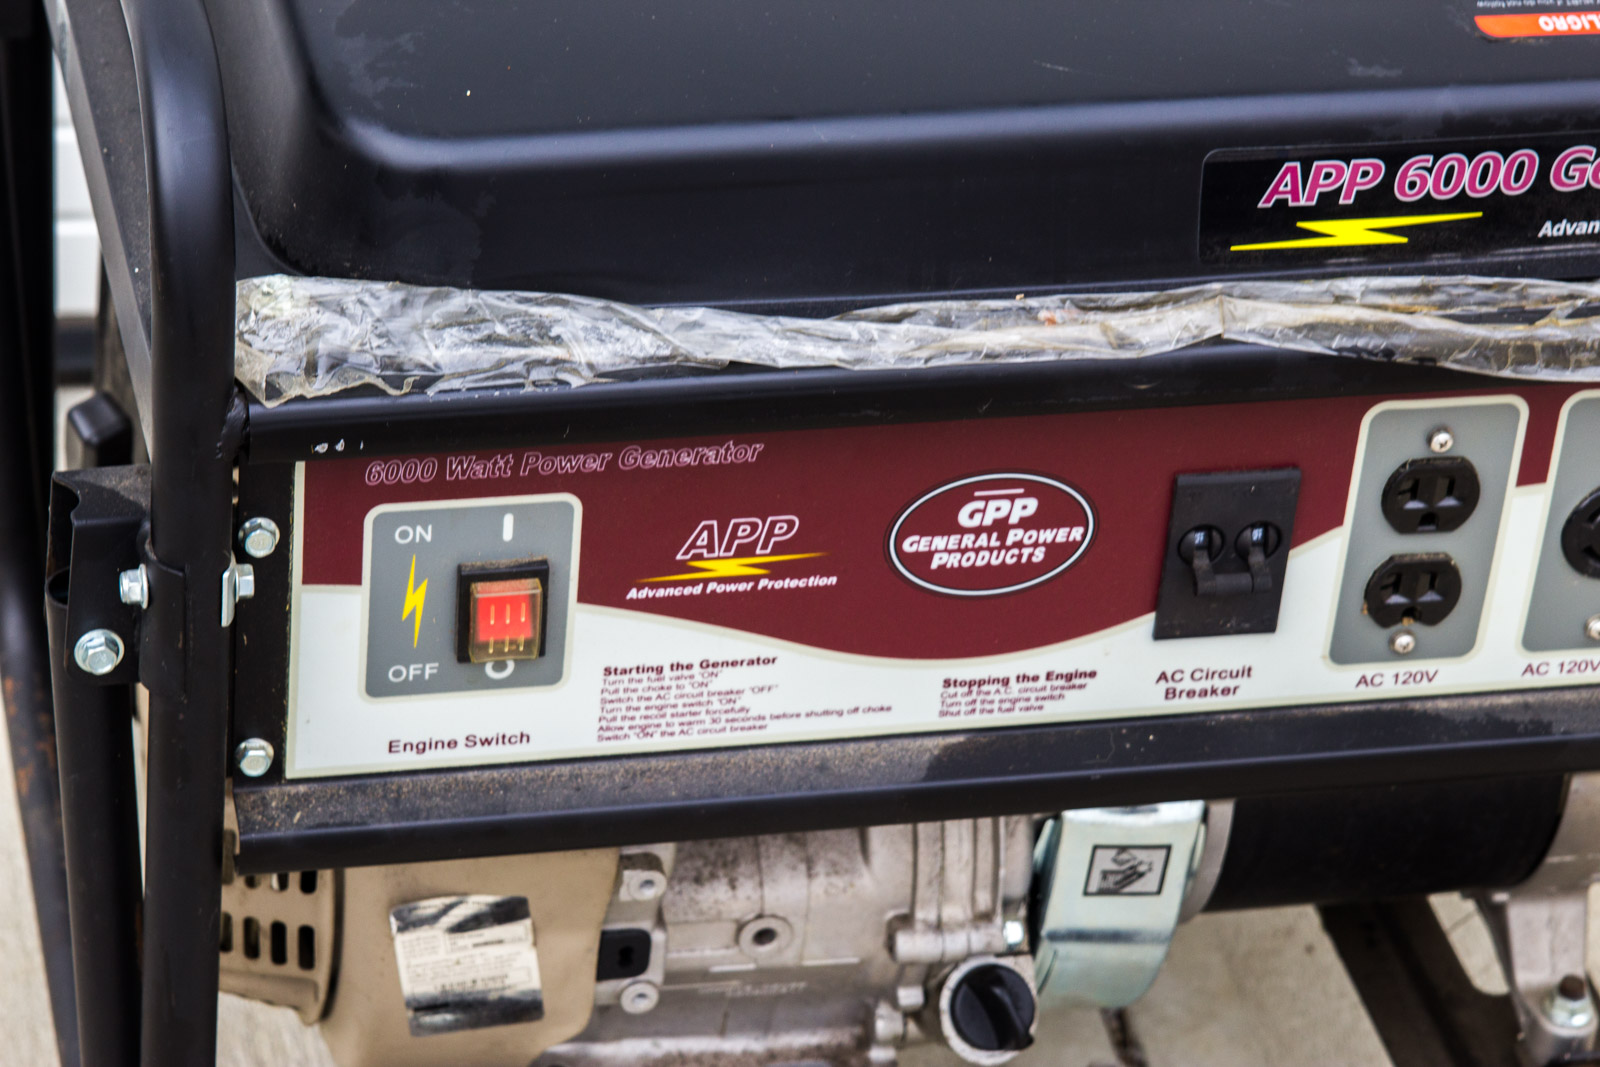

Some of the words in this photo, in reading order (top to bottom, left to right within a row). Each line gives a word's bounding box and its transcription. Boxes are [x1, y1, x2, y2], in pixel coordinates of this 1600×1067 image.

[1257, 158, 1386, 208] APP
[1393, 149, 1540, 202] 6000
[1537, 218, 1600, 238] Advan
[365, 458, 438, 485] 6000
[446, 453, 514, 481] Watt
[520, 449, 612, 477] Power
[618, 440, 763, 471] Generator
[957, 497, 1039, 528] GPP
[394, 524, 433, 544] ON
[675, 514, 799, 560] APP
[902, 532, 1001, 553] GENERAL
[1005, 526, 1085, 546] POWER
[930, 546, 1046, 570] PRODUCTS
[626, 583, 703, 600] Advanced
[706, 579, 754, 595] Power
[757, 574, 838, 591] Protection
[388, 662, 439, 682] OFF
[602, 663, 664, 677] Starting
[670, 661, 694, 672] the
[699, 656, 778, 671] Generator
[1155, 669, 1185, 685] AC
[1190, 664, 1253, 682] Circuit
[1521, 662, 1550, 678] AC
[600, 687, 620, 695] Pull
[623, 686, 639, 694] the
[642, 684, 672, 692] choke
[675, 683, 685, 691] to
[602, 678, 625, 686] Turn
[628, 677, 643, 685] the
[647, 675, 666, 683] fuel
[669, 674, 695, 682] valve
[942, 675, 1010, 690] Stopping
[1015, 672, 1040, 684] the
[1045, 668, 1098, 683] Engine
[1355, 672, 1384, 689] AC
[1392, 670, 1439, 685] 120V
[600, 696, 634, 705] Switch
[637, 695, 653, 703] the
[655, 692, 671, 701] AC
[674, 691, 704, 700] circuit
[707, 688, 746, 697] breaker
[940, 690, 958, 700] Cut
[960, 689, 973, 698] off
[976, 688, 991, 697] the
[1018, 684, 1048, 694] circuit
[1050, 682, 1087, 692] breaker
[940, 700, 961, 709] Turn
[964, 698, 977, 707] off
[980, 698, 995, 706] the
[998, 695, 1032, 706] engine
[1034, 693, 1065, 703] switch
[1164, 685, 1241, 701] Breaker
[598, 715, 618, 724] Pull
[621, 714, 636, 722] the
[670, 709, 702, 719] starter
[705, 706, 751, 716] forcefully
[601, 707, 622, 715] Turn
[625, 705, 641, 713] the
[644, 703, 679, 712] engine
[682, 699, 714, 709] switch
[938, 708, 961, 718] Shut
[963, 707, 977, 716] off
[979, 706, 994, 715] the
[997, 704, 1016, 713] fuel
[1018, 703, 1045, 712] valve
[597, 725, 625, 733] Allow
[628, 723, 662, 733] engine
[678, 719, 706, 728] warm
[710, 717, 722, 725] 30
[725, 714, 767, 724] seconds
[769, 711, 802, 721] before
[804, 706, 844, 718] shutting
[847, 706, 860, 715] off
[862, 704, 892, 714] choke
[388, 738, 458, 755] Engine
[465, 731, 531, 749] Switch
[597, 733, 630, 743] Switch
[660, 730, 676, 738] the
[678, 727, 694, 737] AC
[697, 726, 727, 735] circuit
[730, 723, 768, 733] breaker
